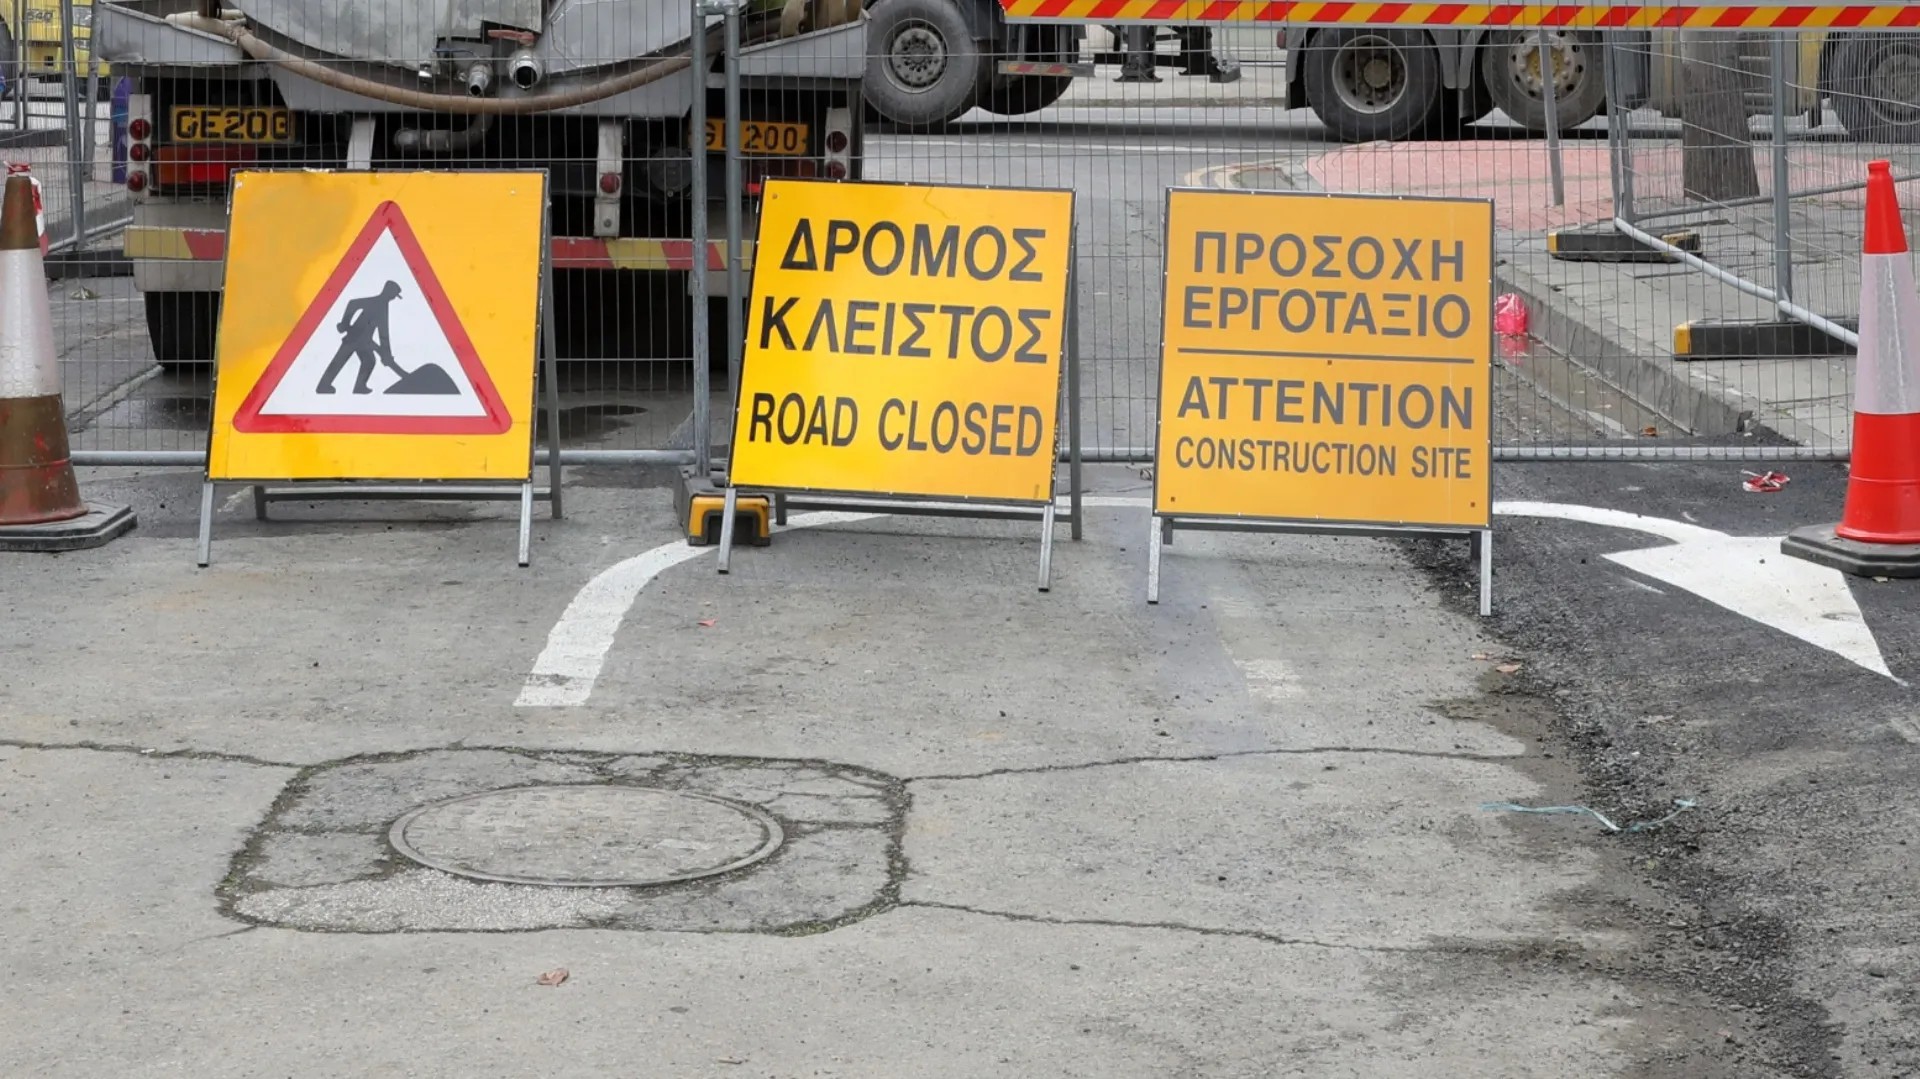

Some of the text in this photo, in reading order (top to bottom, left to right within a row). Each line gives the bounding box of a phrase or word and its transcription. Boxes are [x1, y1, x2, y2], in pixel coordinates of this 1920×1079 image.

[780, 218, 1046, 282] ΔΡΟΜΟΣ
[1194, 231, 1464, 282] ΠΡΟΣΟΧΗ
[759, 296, 1051, 364] ΚΛΕΙΣΤΟΣ
[1183, 285, 1471, 339] ΕΡΓΟΤΑΞΙΟ
[749, 392, 1042, 457] ROAD CLOSED
[1177, 375, 1472, 430] ATTENTION
[1175, 436, 1471, 479] CONSTRUCTION SITE
